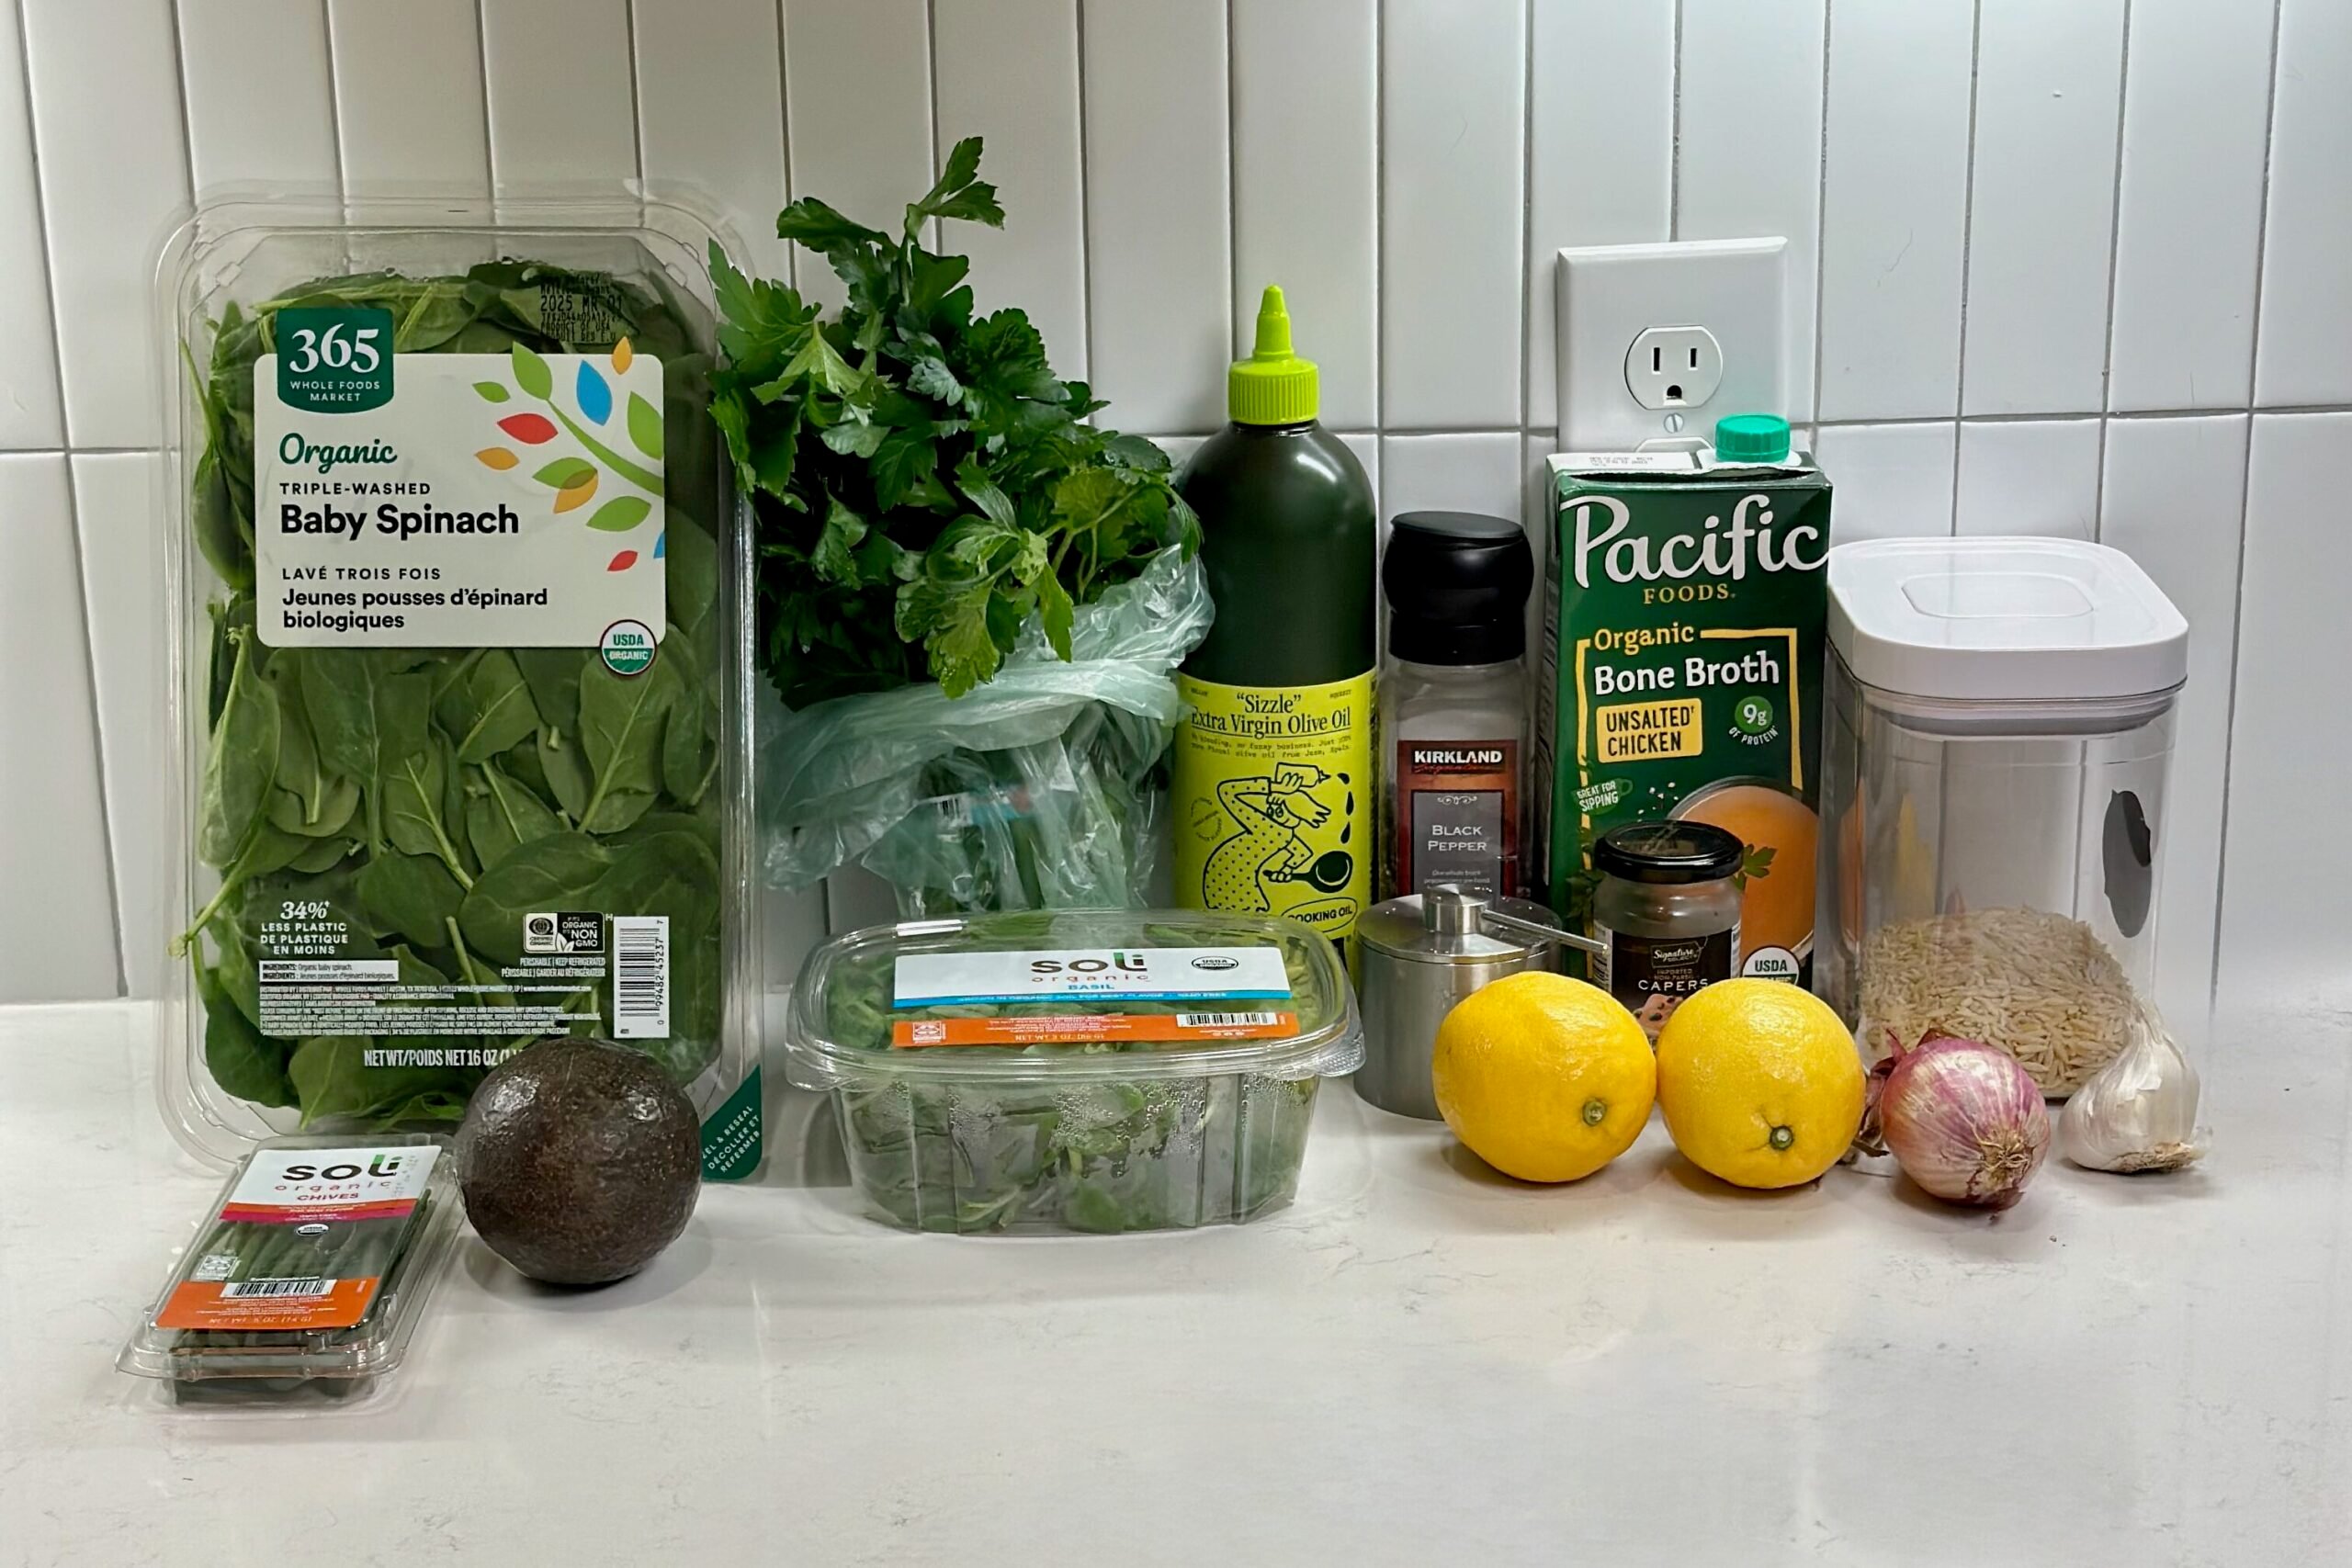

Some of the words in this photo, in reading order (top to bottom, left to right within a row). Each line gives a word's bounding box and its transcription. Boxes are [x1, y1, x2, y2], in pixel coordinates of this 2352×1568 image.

[540, 295, 573, 311] 2025
[289, 323, 380, 373] 365
[289, 380, 334, 390] WHOLE
[339, 380, 380, 390] FOODS
[310, 392, 361, 401] MARKET
[279, 433, 398, 474] Organic
[279, 482, 431, 495] TRIPLE-WASHED
[280, 503, 368, 540] Baby
[376, 503, 520, 541] Spinach
[1560, 493, 1830, 589] Pacific
[282, 566, 328, 581] LAVÉ
[336, 568, 391, 581] TROIS
[399, 568, 441, 581] FOIS
[282, 589, 356, 606] Jeunes
[363, 592, 446, 610] pousses
[450, 588, 548, 610] d’épinard
[1643, 583, 1730, 604] FOODS
[283, 610, 405, 632] biologiques
[613, 634, 645, 646] USDA
[1594, 622, 1694, 656] Organic
[609, 650, 649, 660] ORGANIC
[1594, 665, 1675, 695] Bone
[1685, 649, 1780, 688] Broth
[1230, 713, 1282, 739] Virgin
[1287, 712, 1328, 734] Olive
[1331, 706, 1351, 728] Oil
[1743, 704, 1768, 726] 9g
[1728, 727, 1742, 738] OF
[1608, 731, 1681, 757] CHICKEN
[1414, 750, 1503, 763] KIRKLAND
[1577, 784, 1600, 799] GREAT
[1601, 780, 1616, 792] FOR
[1579, 791, 1619, 812] SIPPING
[1431, 825, 1483, 836] BLACK
[1428, 840, 1487, 852] PEPPER
[1287, 908, 1337, 923] OOKING
[1338, 905, 1353, 917] OIL
[261, 922, 290, 932] LESS
[295, 922, 347, 932] PLASTIC
[571, 930, 598, 939] NON
[260, 934, 277, 944] DE
[280, 934, 349, 944] PLASTIQUE
[273, 945, 289, 954] EN
[294, 945, 335, 954] MOINS
[655, 938, 664, 970] 45237
[1654, 948, 1695, 963] Signature
[1755, 959, 1788, 972] USDA
[1032, 974, 1149, 984] organic
[1638, 978, 1709, 992] CAPERS
[655, 975, 664, 1007] 99482
[364, 1049, 386, 1066] NET
[445, 1049, 466, 1066] NET
[467, 1049, 481, 1066] 16
[482, 1049, 498, 1066] OZ
[724, 1106, 753, 1136] RESEAL
[749, 1114, 760, 1128] ET
[720, 1130, 761, 1173] REFERMER
[275, 1181, 392, 1192] organic
[297, 1193, 359, 1201] CHIVES
